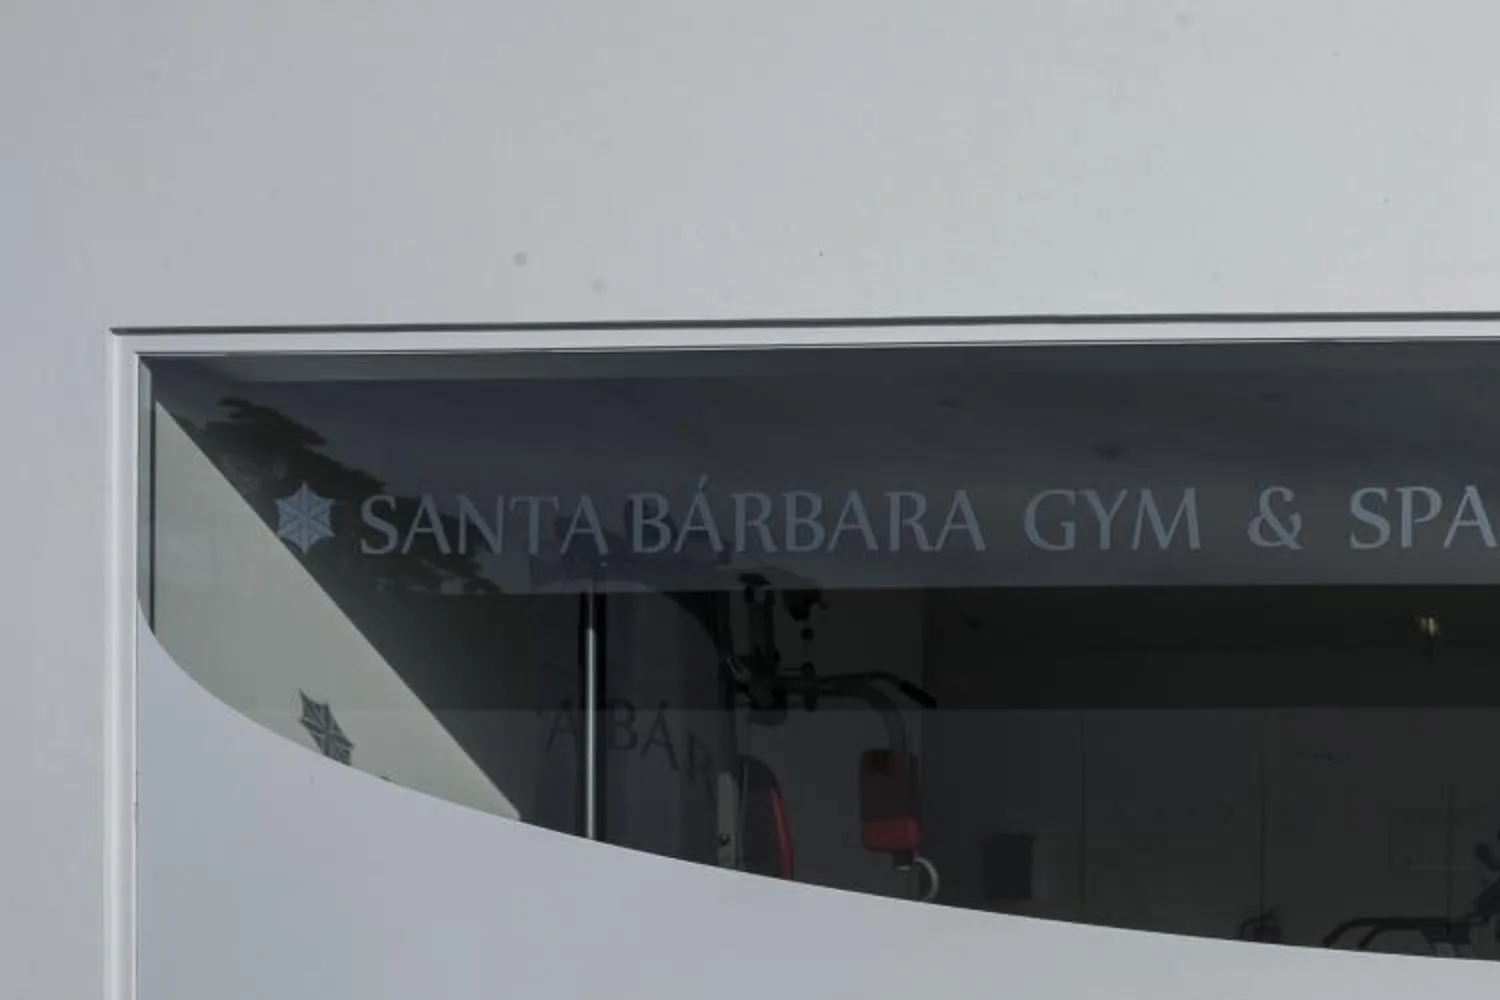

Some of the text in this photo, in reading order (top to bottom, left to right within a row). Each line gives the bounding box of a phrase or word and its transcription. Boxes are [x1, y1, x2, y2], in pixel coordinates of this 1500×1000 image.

[359, 474, 1499, 555] SANTA BÁRBARA GYM & SPA
